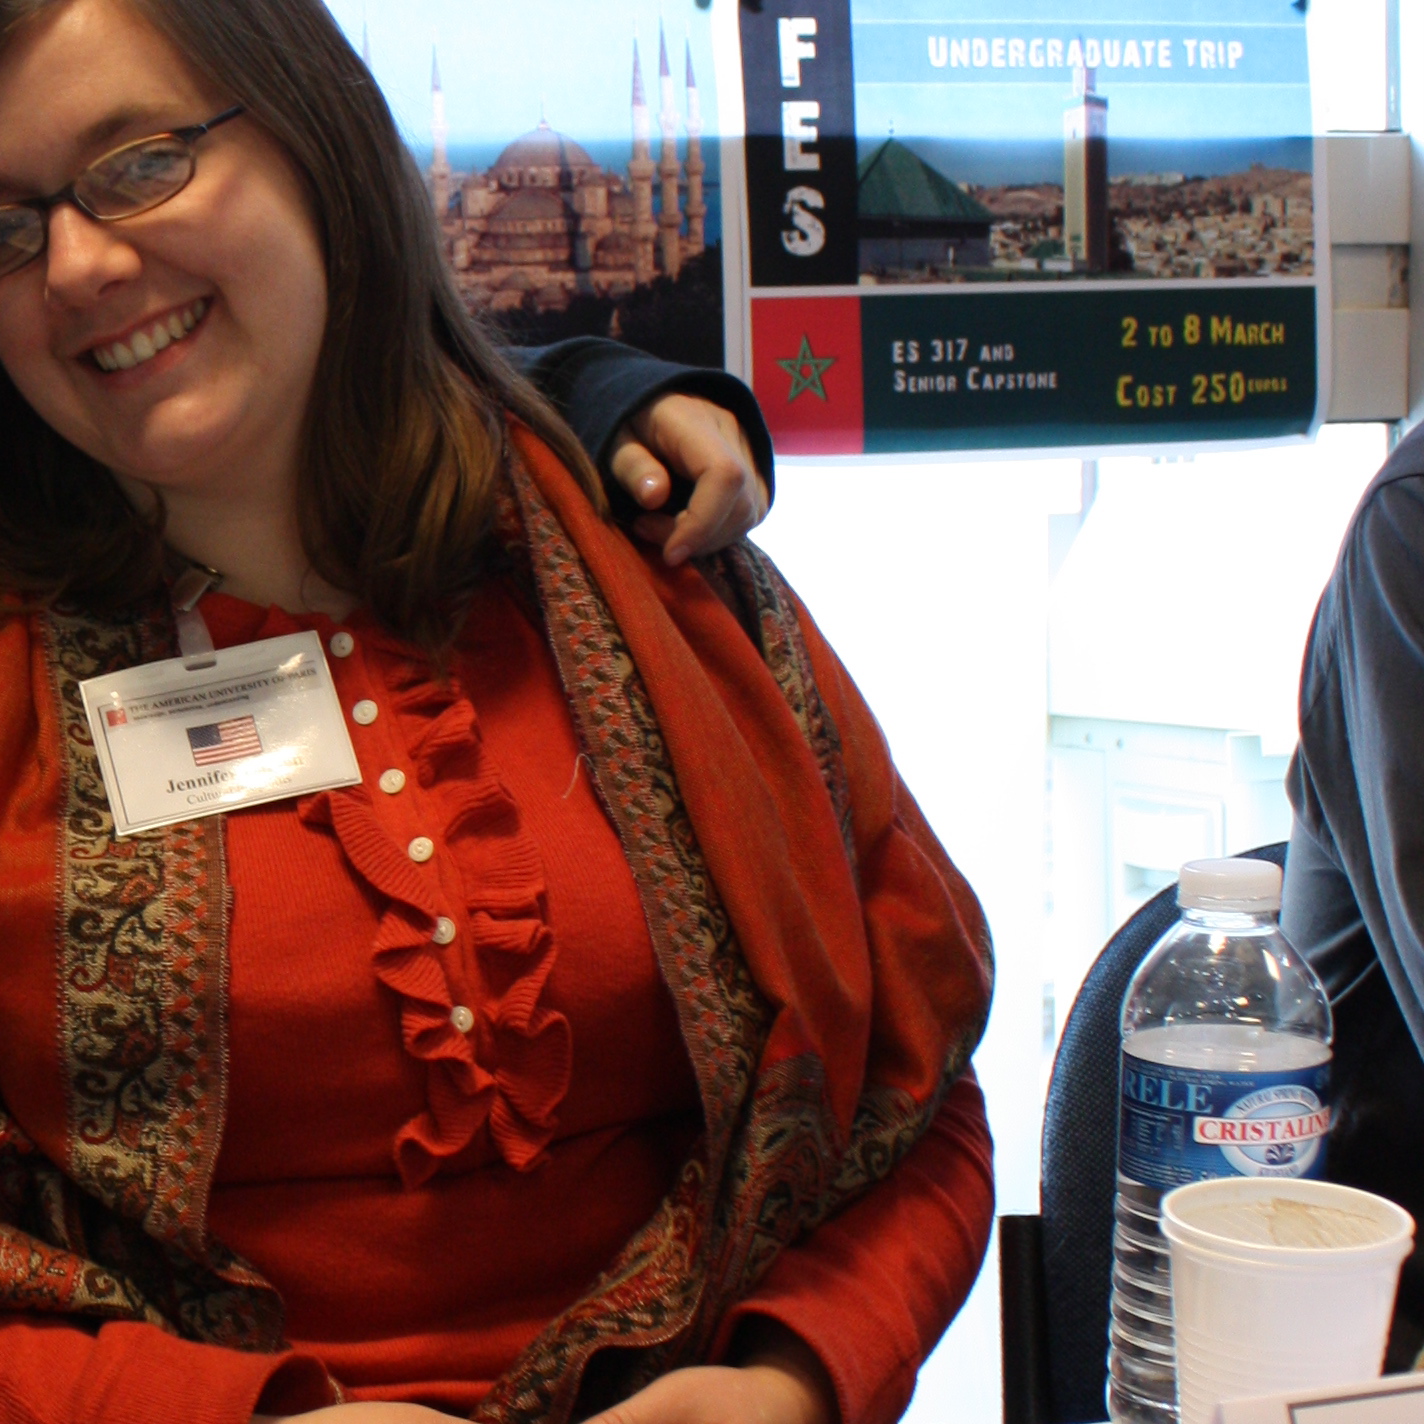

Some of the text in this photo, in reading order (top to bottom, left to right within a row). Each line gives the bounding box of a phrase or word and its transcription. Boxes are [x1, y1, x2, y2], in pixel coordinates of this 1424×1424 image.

[927, 35, 1244, 70] UNDERGRADUATE TRIP
[1121, 315, 1285, 348] 2 TO 8 MARCH
[892, 339, 1016, 364] ES 317 AND
[893, 367, 1058, 393] SENIOR CAPSTONE
[1116, 375, 1178, 407] COST
[150, 691, 208, 710] AMERICAN
[208, 677, 271, 701] UNIVERSITY
